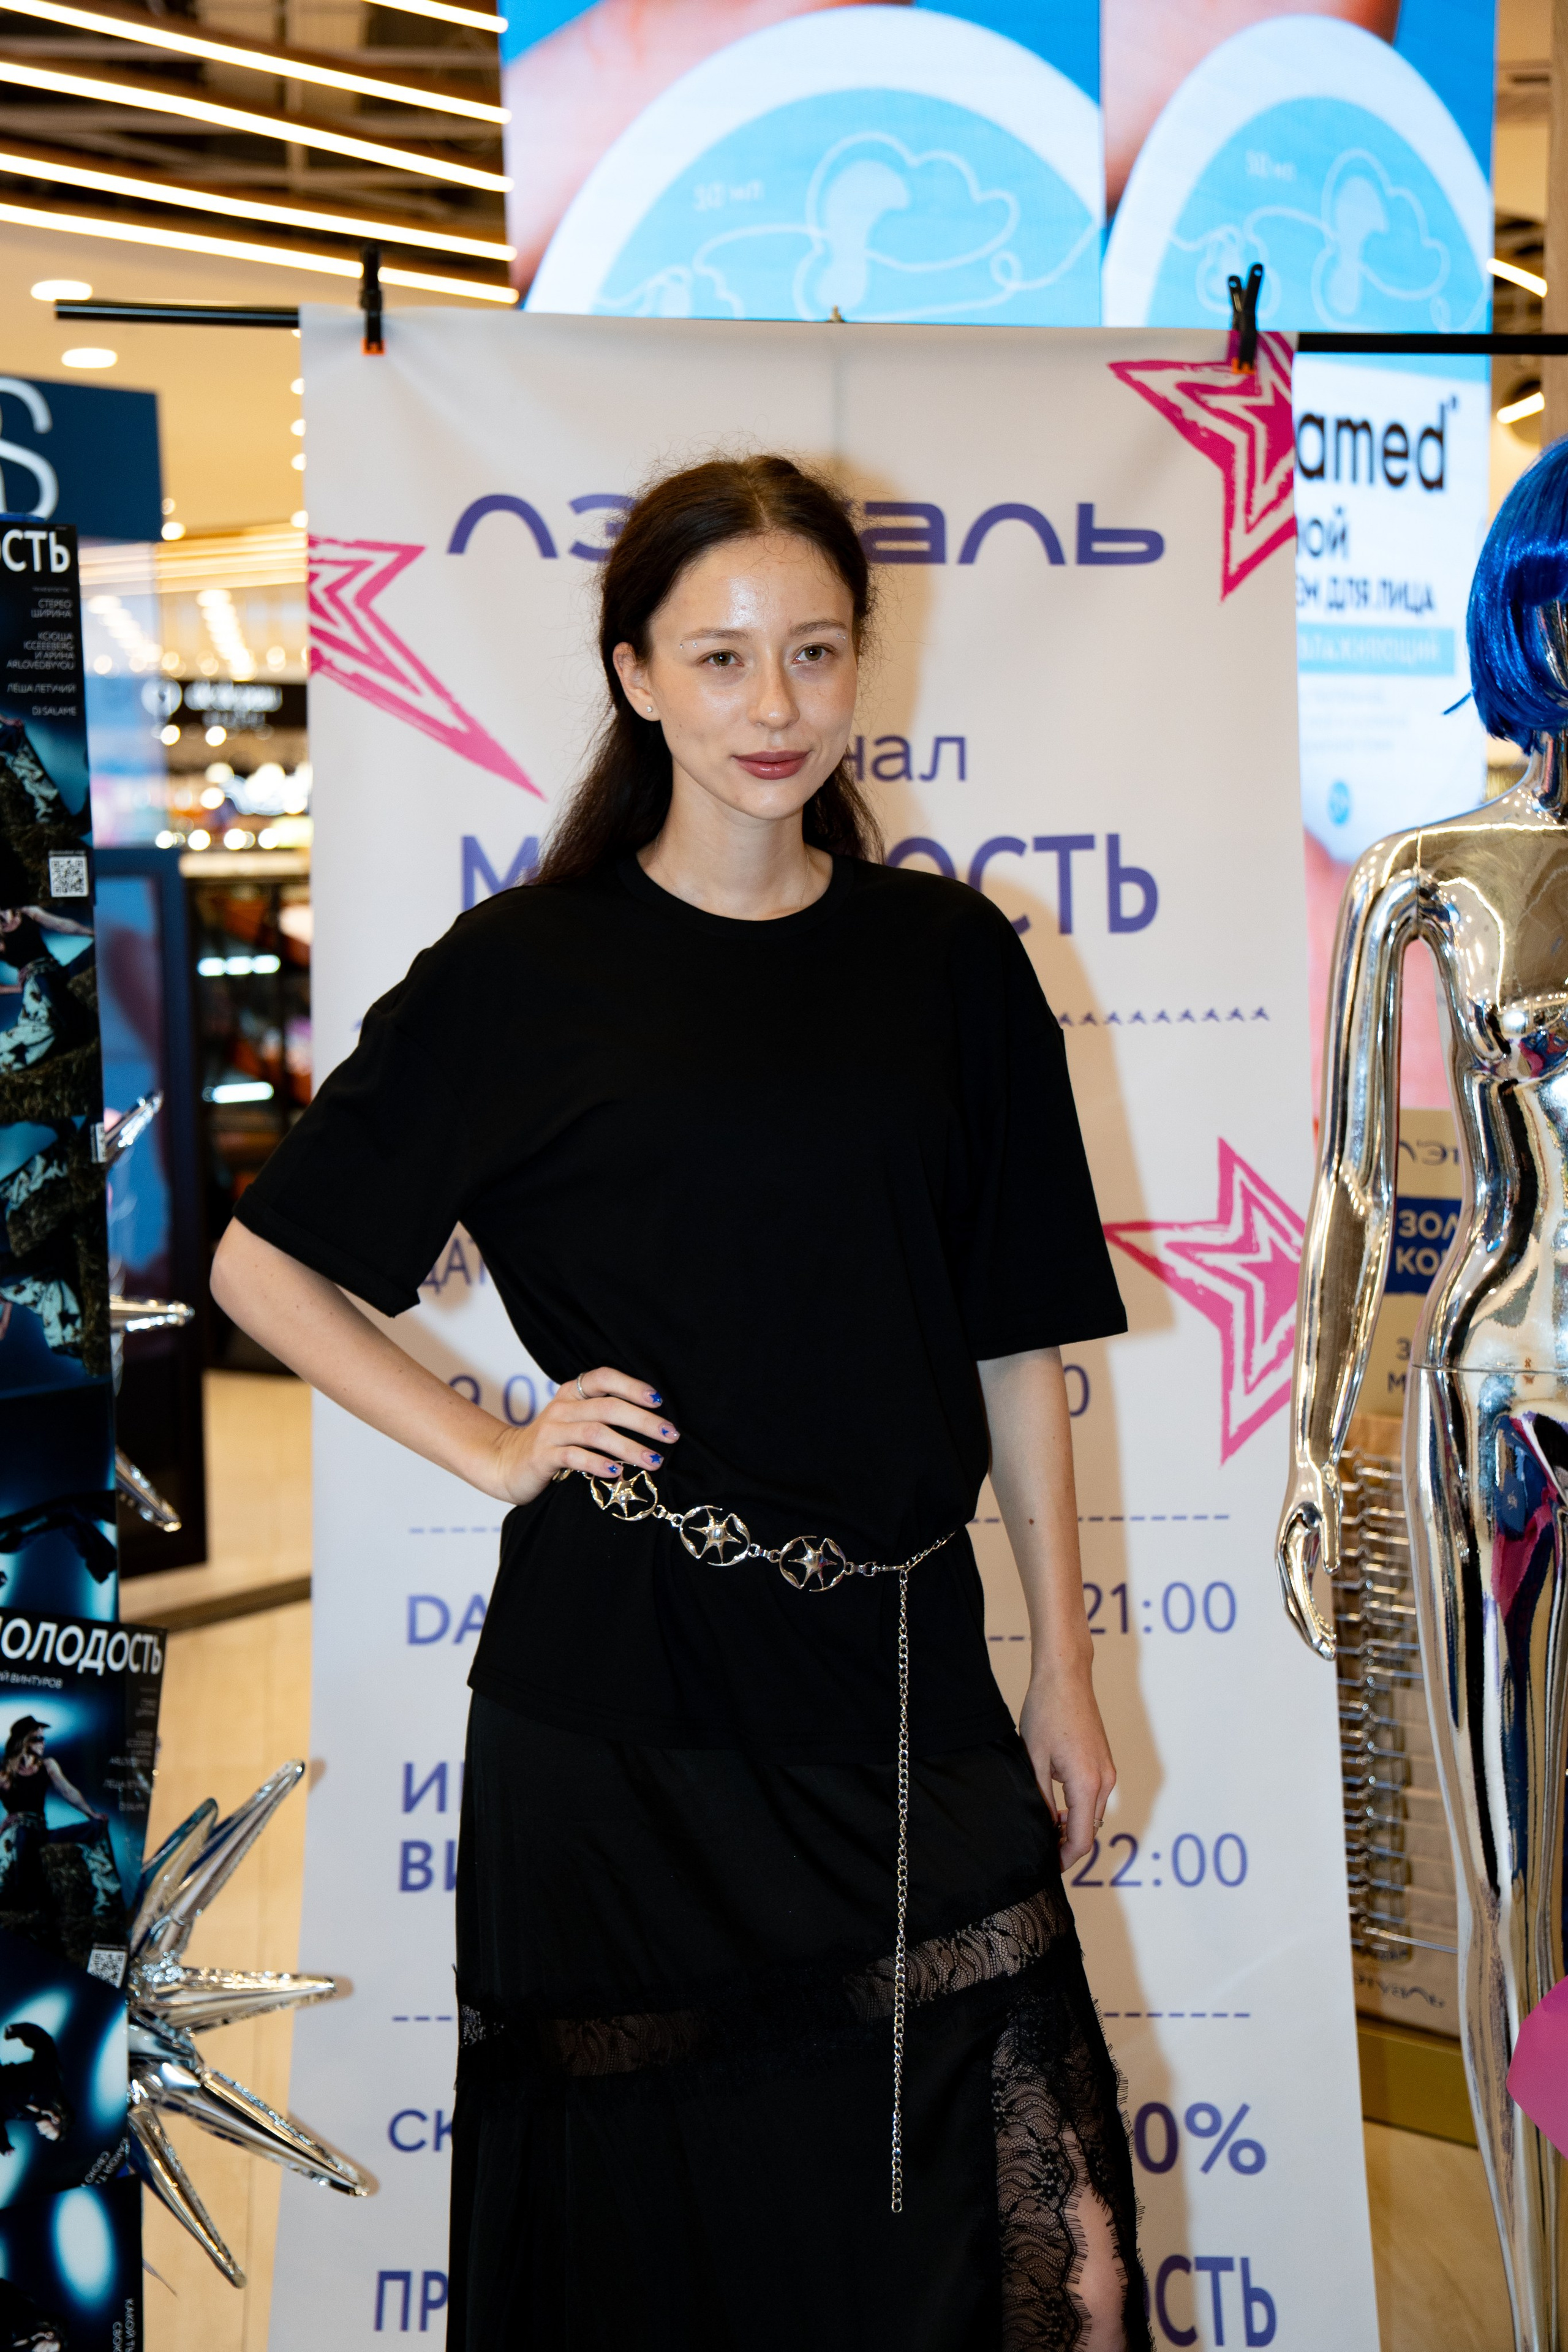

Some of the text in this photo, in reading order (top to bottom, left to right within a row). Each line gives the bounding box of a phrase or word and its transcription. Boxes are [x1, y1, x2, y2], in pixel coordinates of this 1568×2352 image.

[1295, 403, 1445, 492] amed
[0, 529, 70, 573] СТЬ
[1298, 505, 1349, 559] ой
[31, 609, 72, 618] ШИРИНА
[38, 598, 73, 609] СТЕРЕО
[843, 734, 967, 782] нал
[0, 1616, 163, 1676] ОЛОДОСТЬ
[1071, 1833, 1248, 1888] 22:00
[1133, 2101, 1267, 2176] 0%
[125, 2298, 137, 2339] КАКОЙ
[1144, 2253, 1278, 2348] СТЬ
